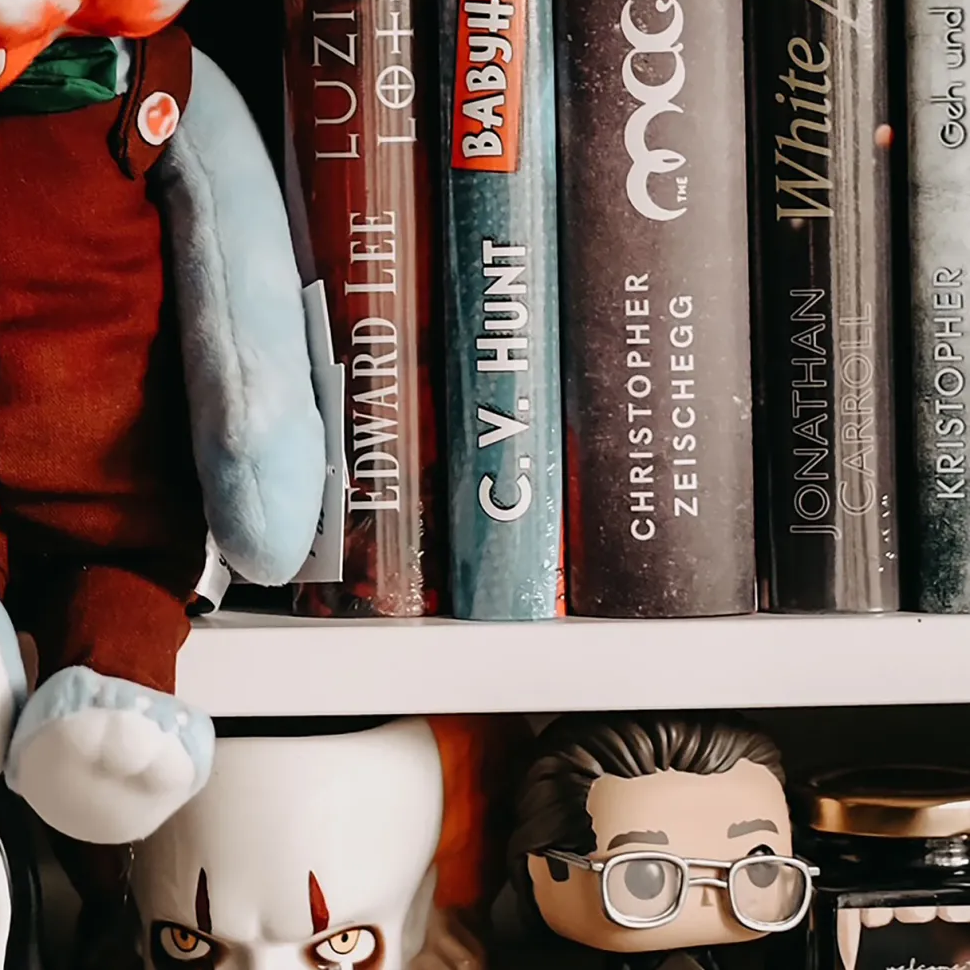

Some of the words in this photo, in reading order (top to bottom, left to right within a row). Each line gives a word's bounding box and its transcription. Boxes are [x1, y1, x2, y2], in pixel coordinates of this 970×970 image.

[775, 36, 834, 221] White
[928, 7, 966, 70] und
[930, 81, 967, 149] Geh
[344, 211, 397, 296] LEE
[476, 240, 529, 372] HUNT
[347, 316, 400, 513] EDWARD
[478, 398, 530, 448] V.
[624, 272, 656, 541] CHRISTOPHER
[669, 295, 698, 517] ZEISCHEGG
[790, 287, 841, 540] JONATHAN
[837, 303, 876, 516] CARROLL
[933, 267, 965, 499] KRISTOPHER
[479, 456, 532, 522] C.
